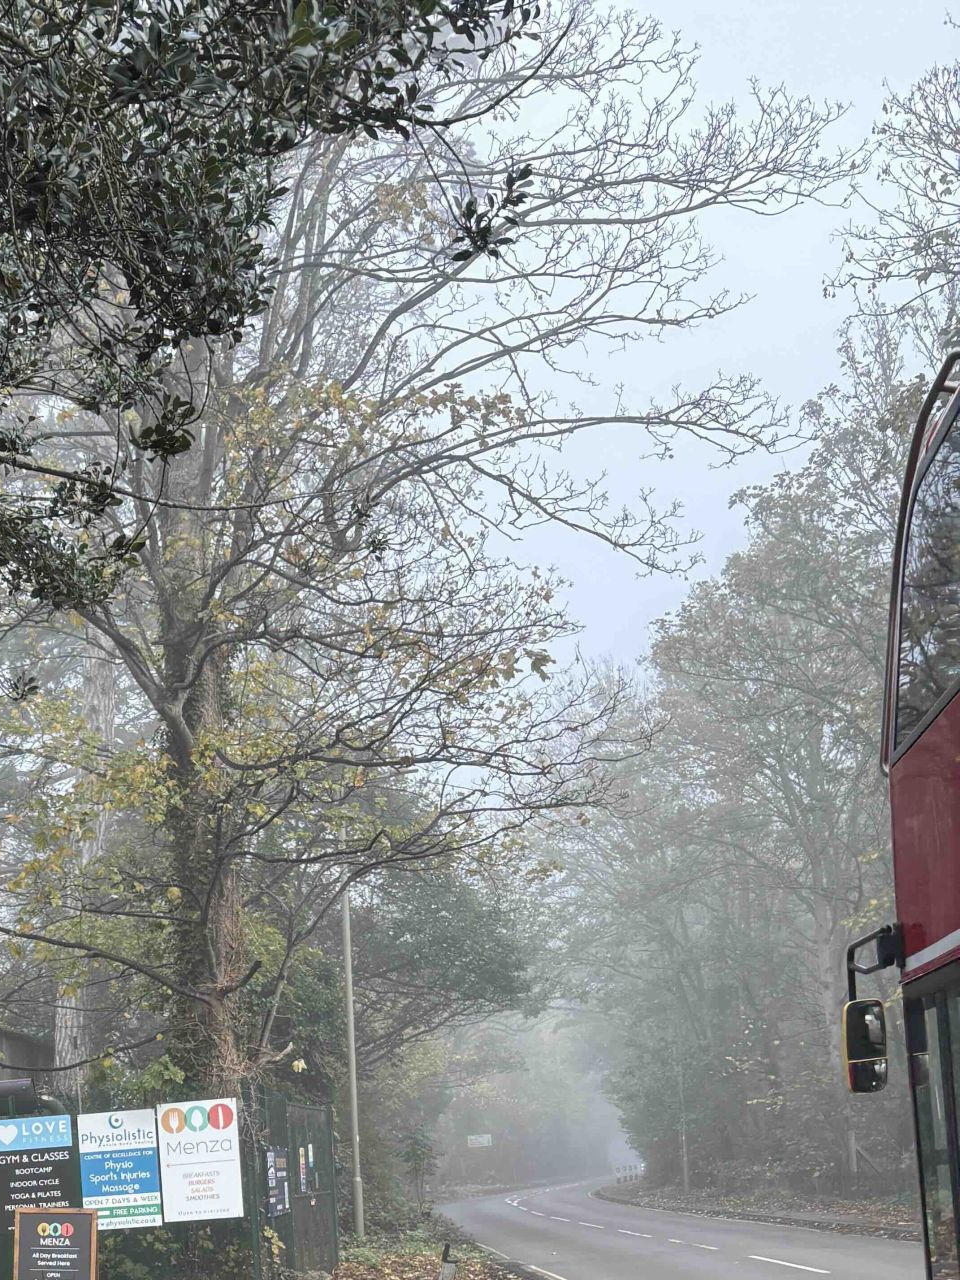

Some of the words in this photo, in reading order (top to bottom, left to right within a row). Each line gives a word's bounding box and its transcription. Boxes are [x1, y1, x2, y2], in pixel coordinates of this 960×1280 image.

[22, 1120, 67, 1136] LOVE
[81, 1129, 154, 1147] Physiolistic
[166, 1138, 232, 1156] Menza
[22, 1154, 29, 1163] &
[31, 1151, 69, 1162] CLASSES
[15, 1166, 53, 1175] BOOTCAMP
[104, 1161, 134, 1172] Physio
[89, 1173, 118, 1183] Sports
[120, 1171, 151, 1182] Injuries
[9, 1180, 37, 1188] INDOOR
[38, 1178, 60, 1186] CYCLE
[101, 1183, 140, 1194] Massage
[10, 1192, 30, 1200] YOGA
[37, 1190, 61, 1198] PILATES
[39, 1201, 70, 1209] TRAINERS
[84, 1199, 104, 1207] OPEN
[111, 1196, 131, 1205] DAYS
[113, 1208, 129, 1216] FREE
[129, 1206, 158, 1215] PARKING
[40, 1237, 71, 1247] MENZA
[39, 1252, 51, 1260] Day
